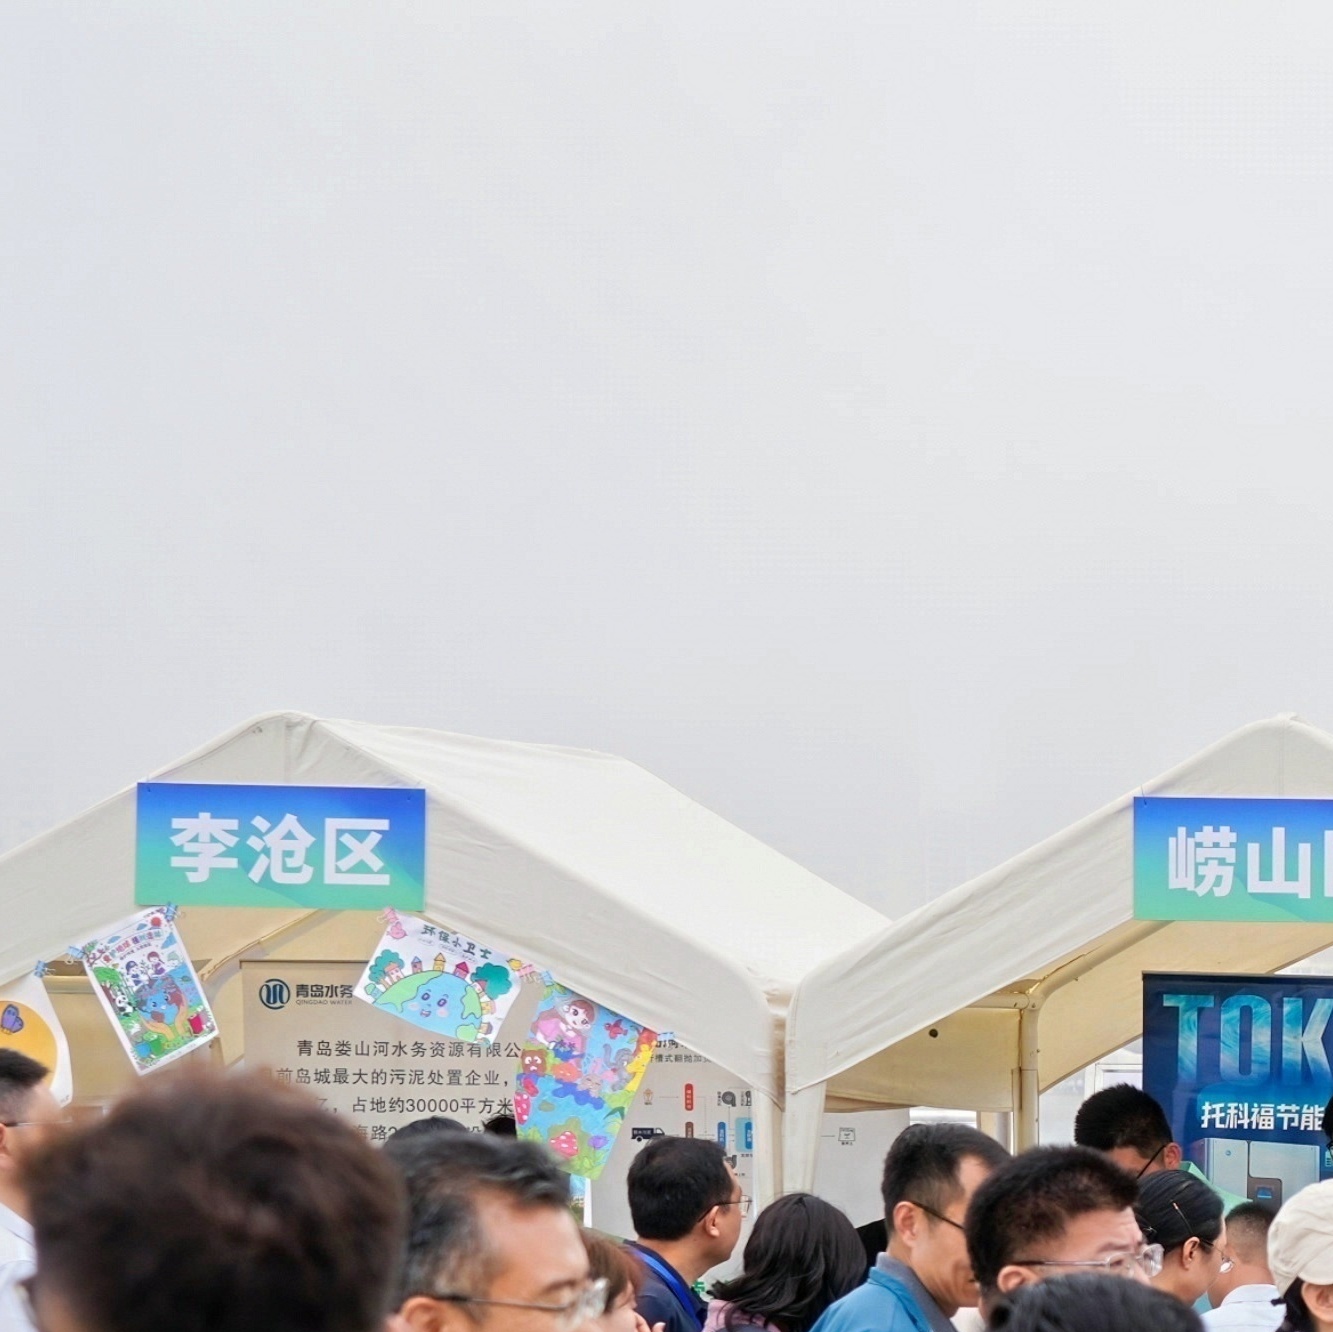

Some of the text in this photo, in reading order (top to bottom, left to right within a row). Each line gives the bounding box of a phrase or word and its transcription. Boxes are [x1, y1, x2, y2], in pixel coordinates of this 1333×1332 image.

[170, 812, 391, 886] 李沧区
[421, 924, 492, 960] 环保小卫士
[296, 984, 353, 998] 青岛水务
[296, 1040, 522, 1059] 青岛娄山河水务资源有限公
[1201, 1102, 1325, 1131] 托科福节能
